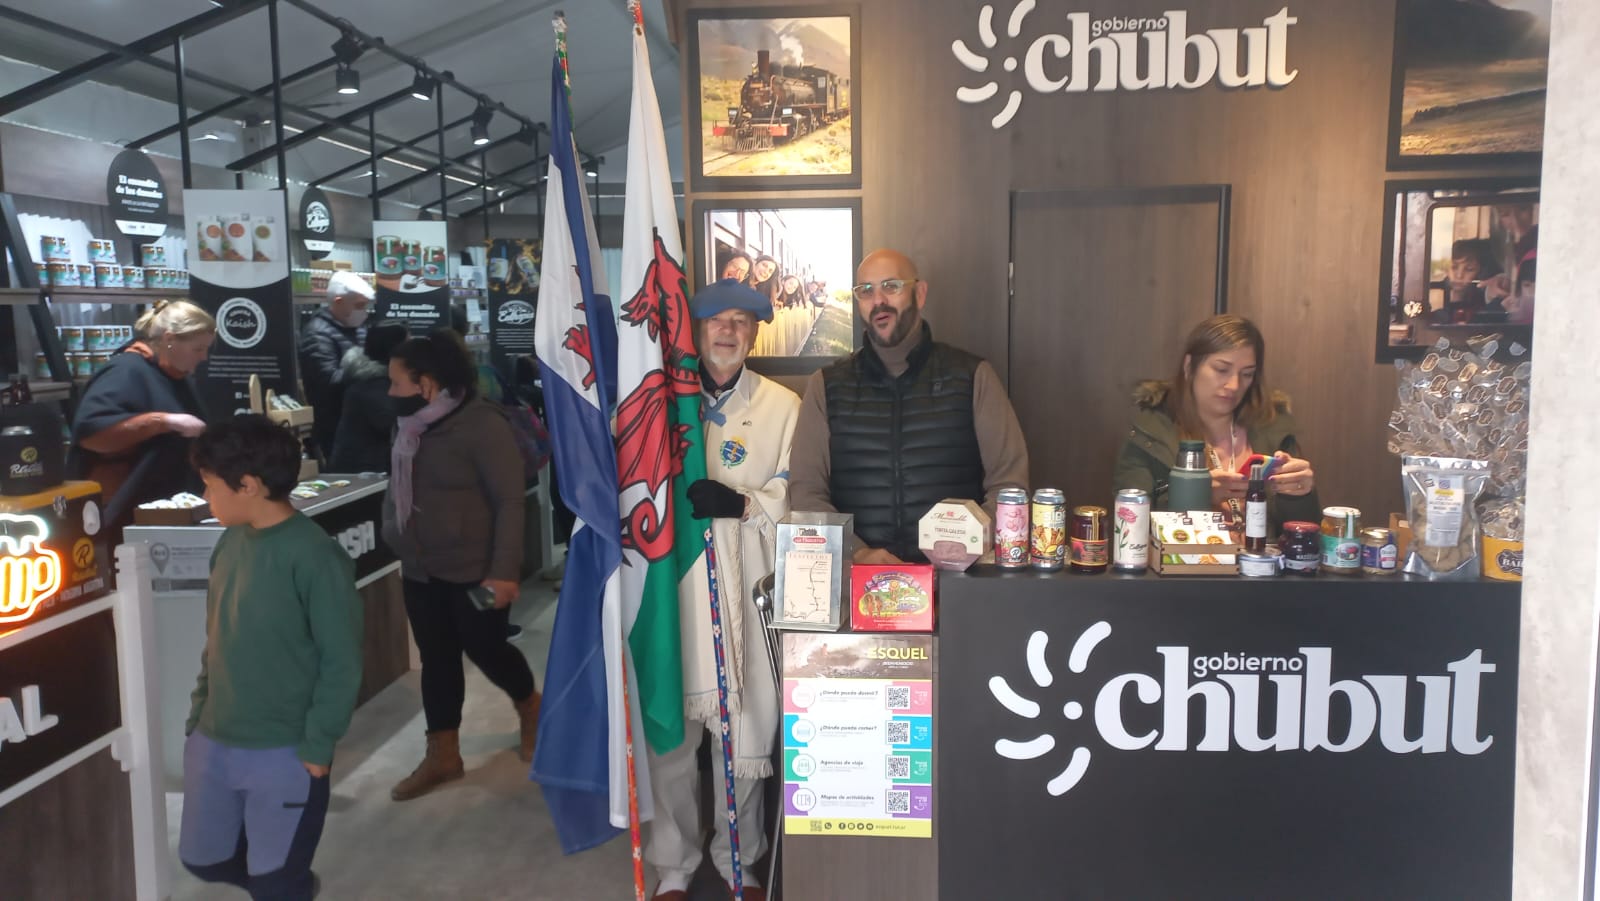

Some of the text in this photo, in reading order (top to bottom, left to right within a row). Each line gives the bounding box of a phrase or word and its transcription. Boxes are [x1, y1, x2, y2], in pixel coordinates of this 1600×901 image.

[1091, 16, 1168, 36] gobierno
[1024, 6, 1298, 93] chubut
[868, 647, 928, 660] ESQUEL
[1193, 652, 1303, 678] gobierno
[1094, 646, 1496, 755] chubut
